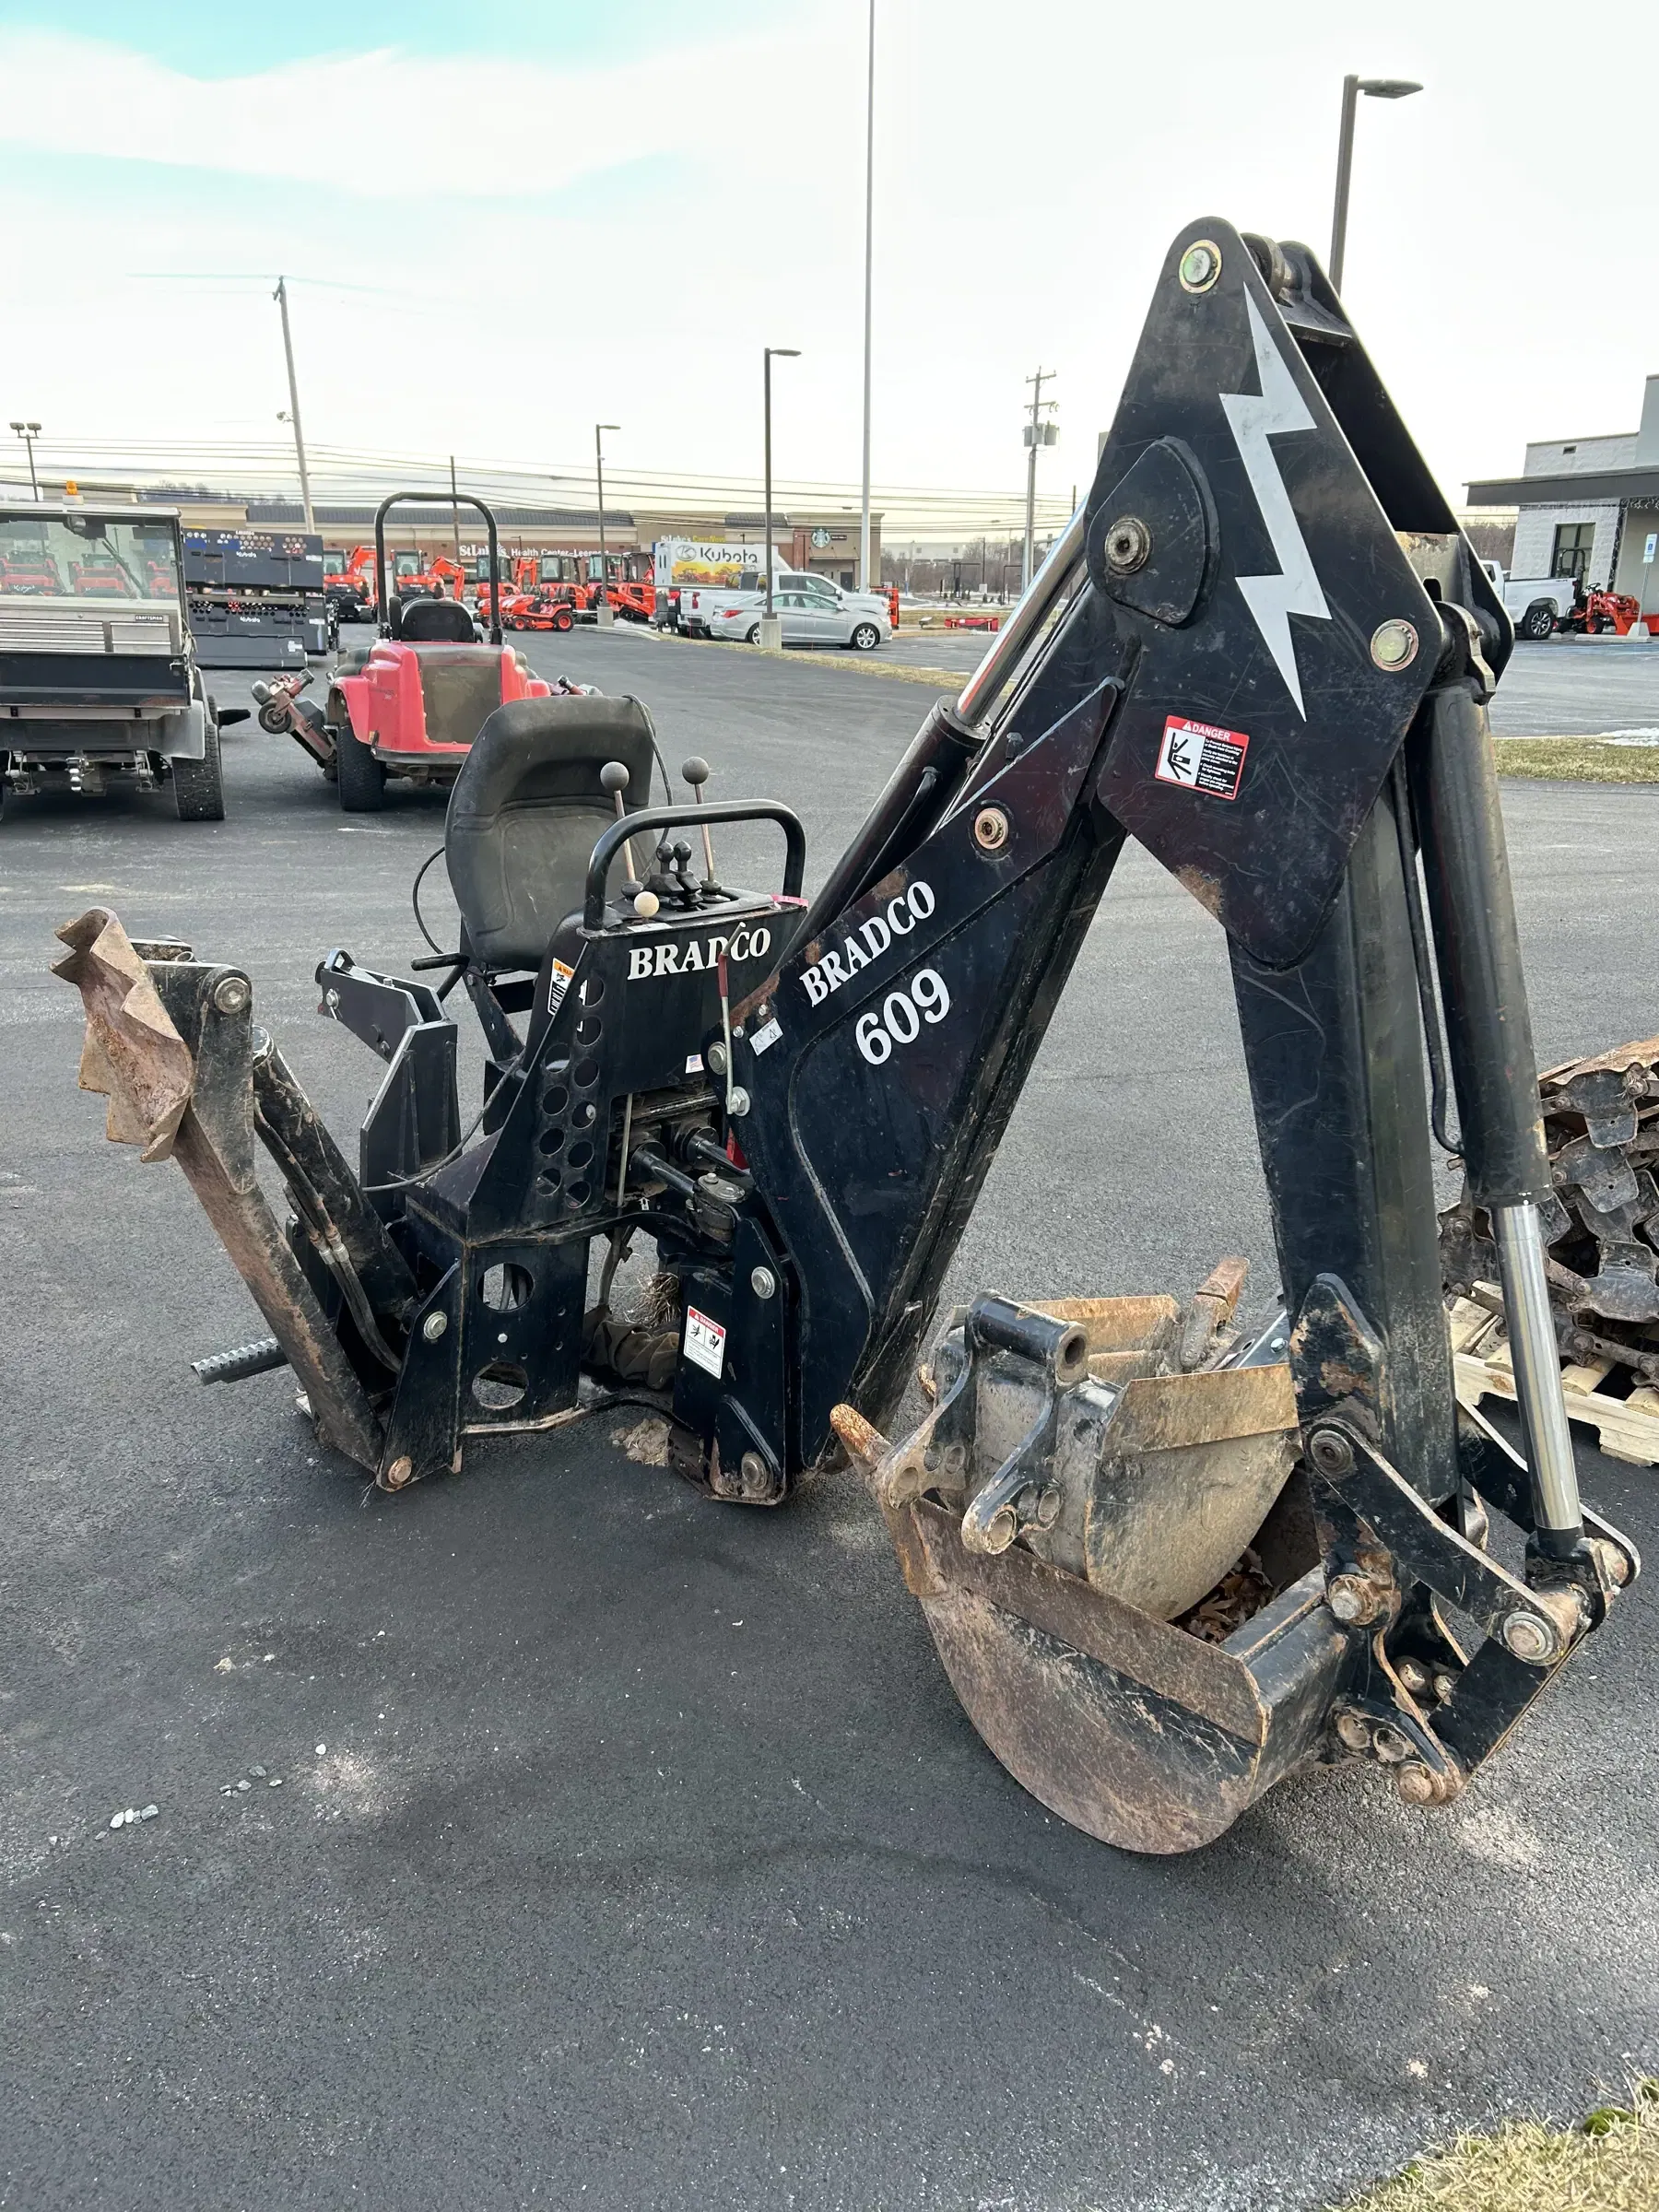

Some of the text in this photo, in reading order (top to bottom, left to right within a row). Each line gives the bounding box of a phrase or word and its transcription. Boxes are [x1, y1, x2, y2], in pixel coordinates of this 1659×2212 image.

[700, 547, 758, 563] Kubota
[1192, 724, 1231, 742] DANGER
[628, 927, 771, 981] BRADCO
[799, 881, 935, 1007] BRADCO
[855, 969, 950, 1065] 609
[700, 1315, 719, 1334] DANGER
